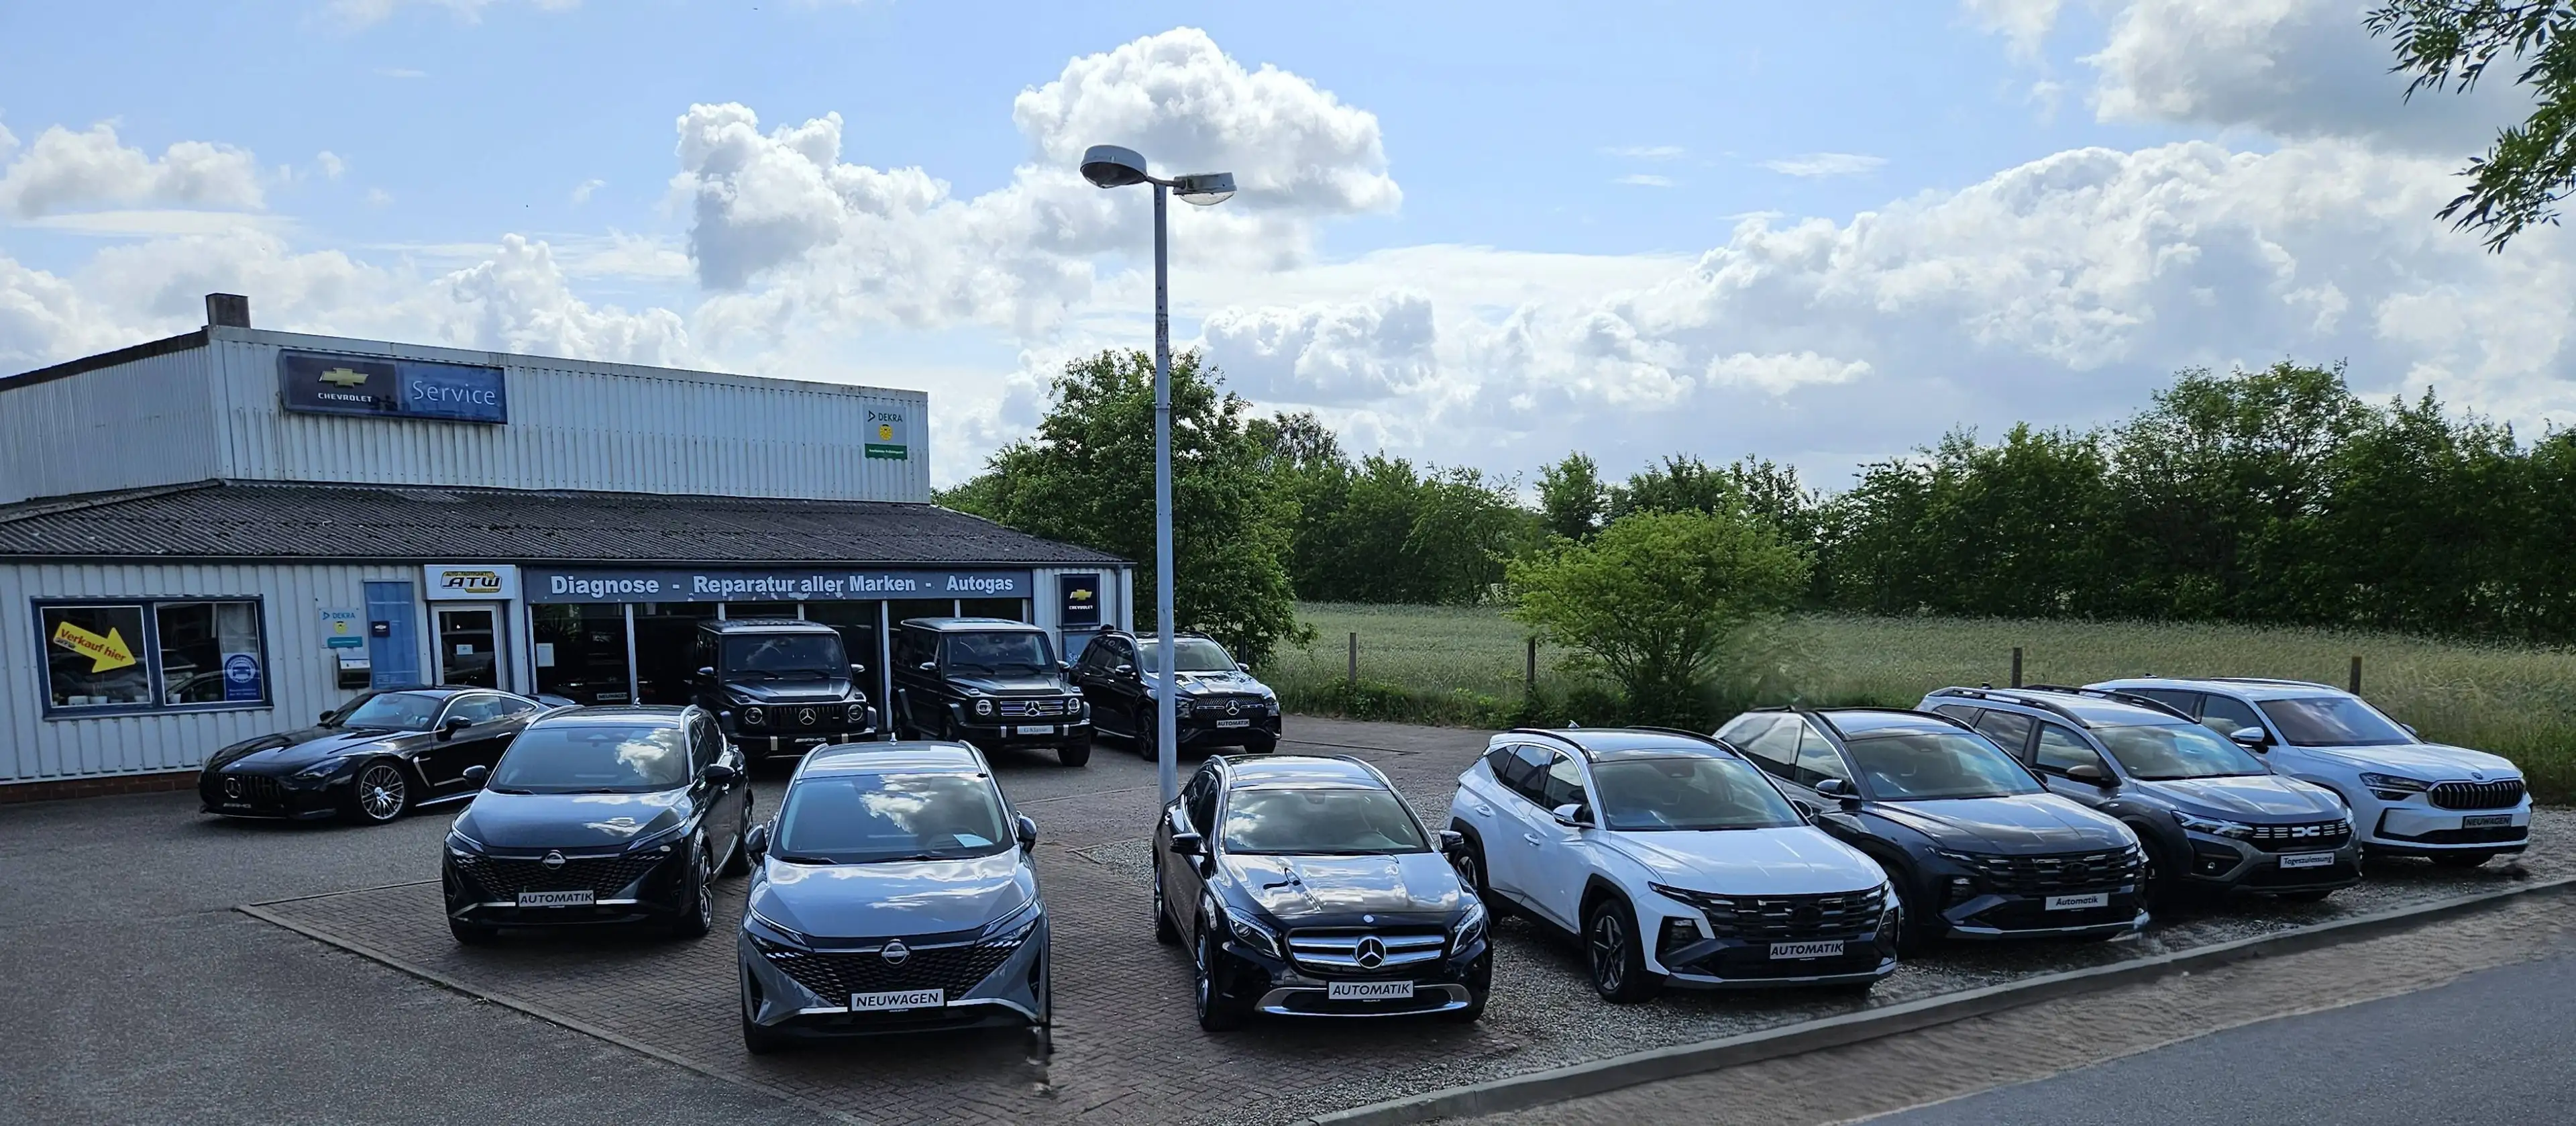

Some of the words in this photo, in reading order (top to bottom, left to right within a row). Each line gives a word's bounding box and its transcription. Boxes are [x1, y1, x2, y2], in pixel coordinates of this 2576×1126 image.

[317, 392, 372, 403] CHEVROLET
[412, 380, 496, 405] Service
[878, 412, 903, 422] DEKRA
[442, 576, 500, 587] ATW
[551, 575, 659, 599] Diagnose
[693, 575, 796, 597] Reparatur
[800, 575, 845, 592] aller
[849, 575, 916, 593] Marken
[946, 574, 1014, 595] Autogas
[60, 628, 105, 654] Verkauf
[103, 646, 127, 662] hier
[2466, 817, 2510, 826] NEUWAGEN
[520, 893, 593, 904] AUTOMATIK
[2055, 896, 2098, 906] Automatik
[1771, 943, 1843, 956] AUTOMATIK
[1333, 984, 1410, 996] AUTOMATIK
[856, 992, 938, 1007] NEUWAGEN
